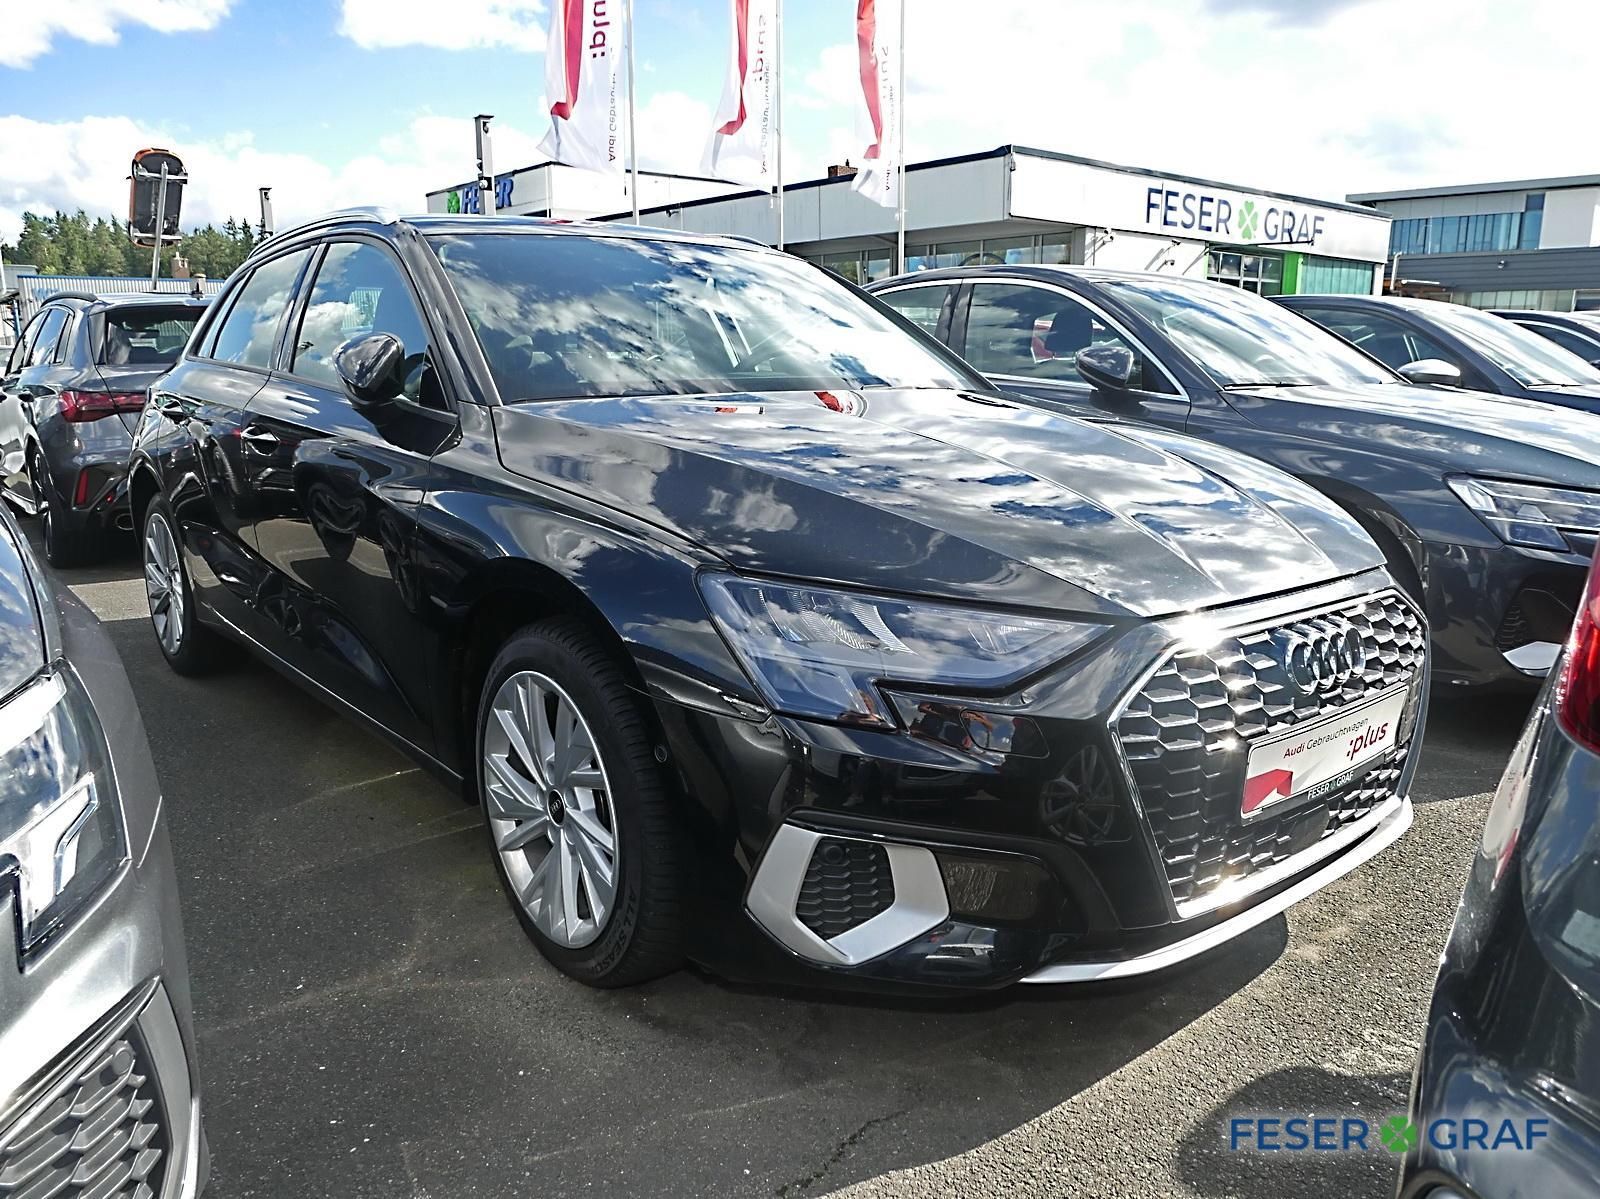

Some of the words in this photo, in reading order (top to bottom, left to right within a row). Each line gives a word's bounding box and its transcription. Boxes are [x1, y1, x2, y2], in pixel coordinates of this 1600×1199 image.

[460, 177, 514, 214] FEER
[1145, 187, 1233, 235] FESER
[1263, 207, 1326, 243] GRAF
[1283, 743, 1305, 759] Audi
[1306, 717, 1369, 750] Gebrauchtwagen
[1346, 722, 1389, 761] :plus
[1307, 783, 1330, 801] FESER
[1336, 771, 1354, 787] GRAF
